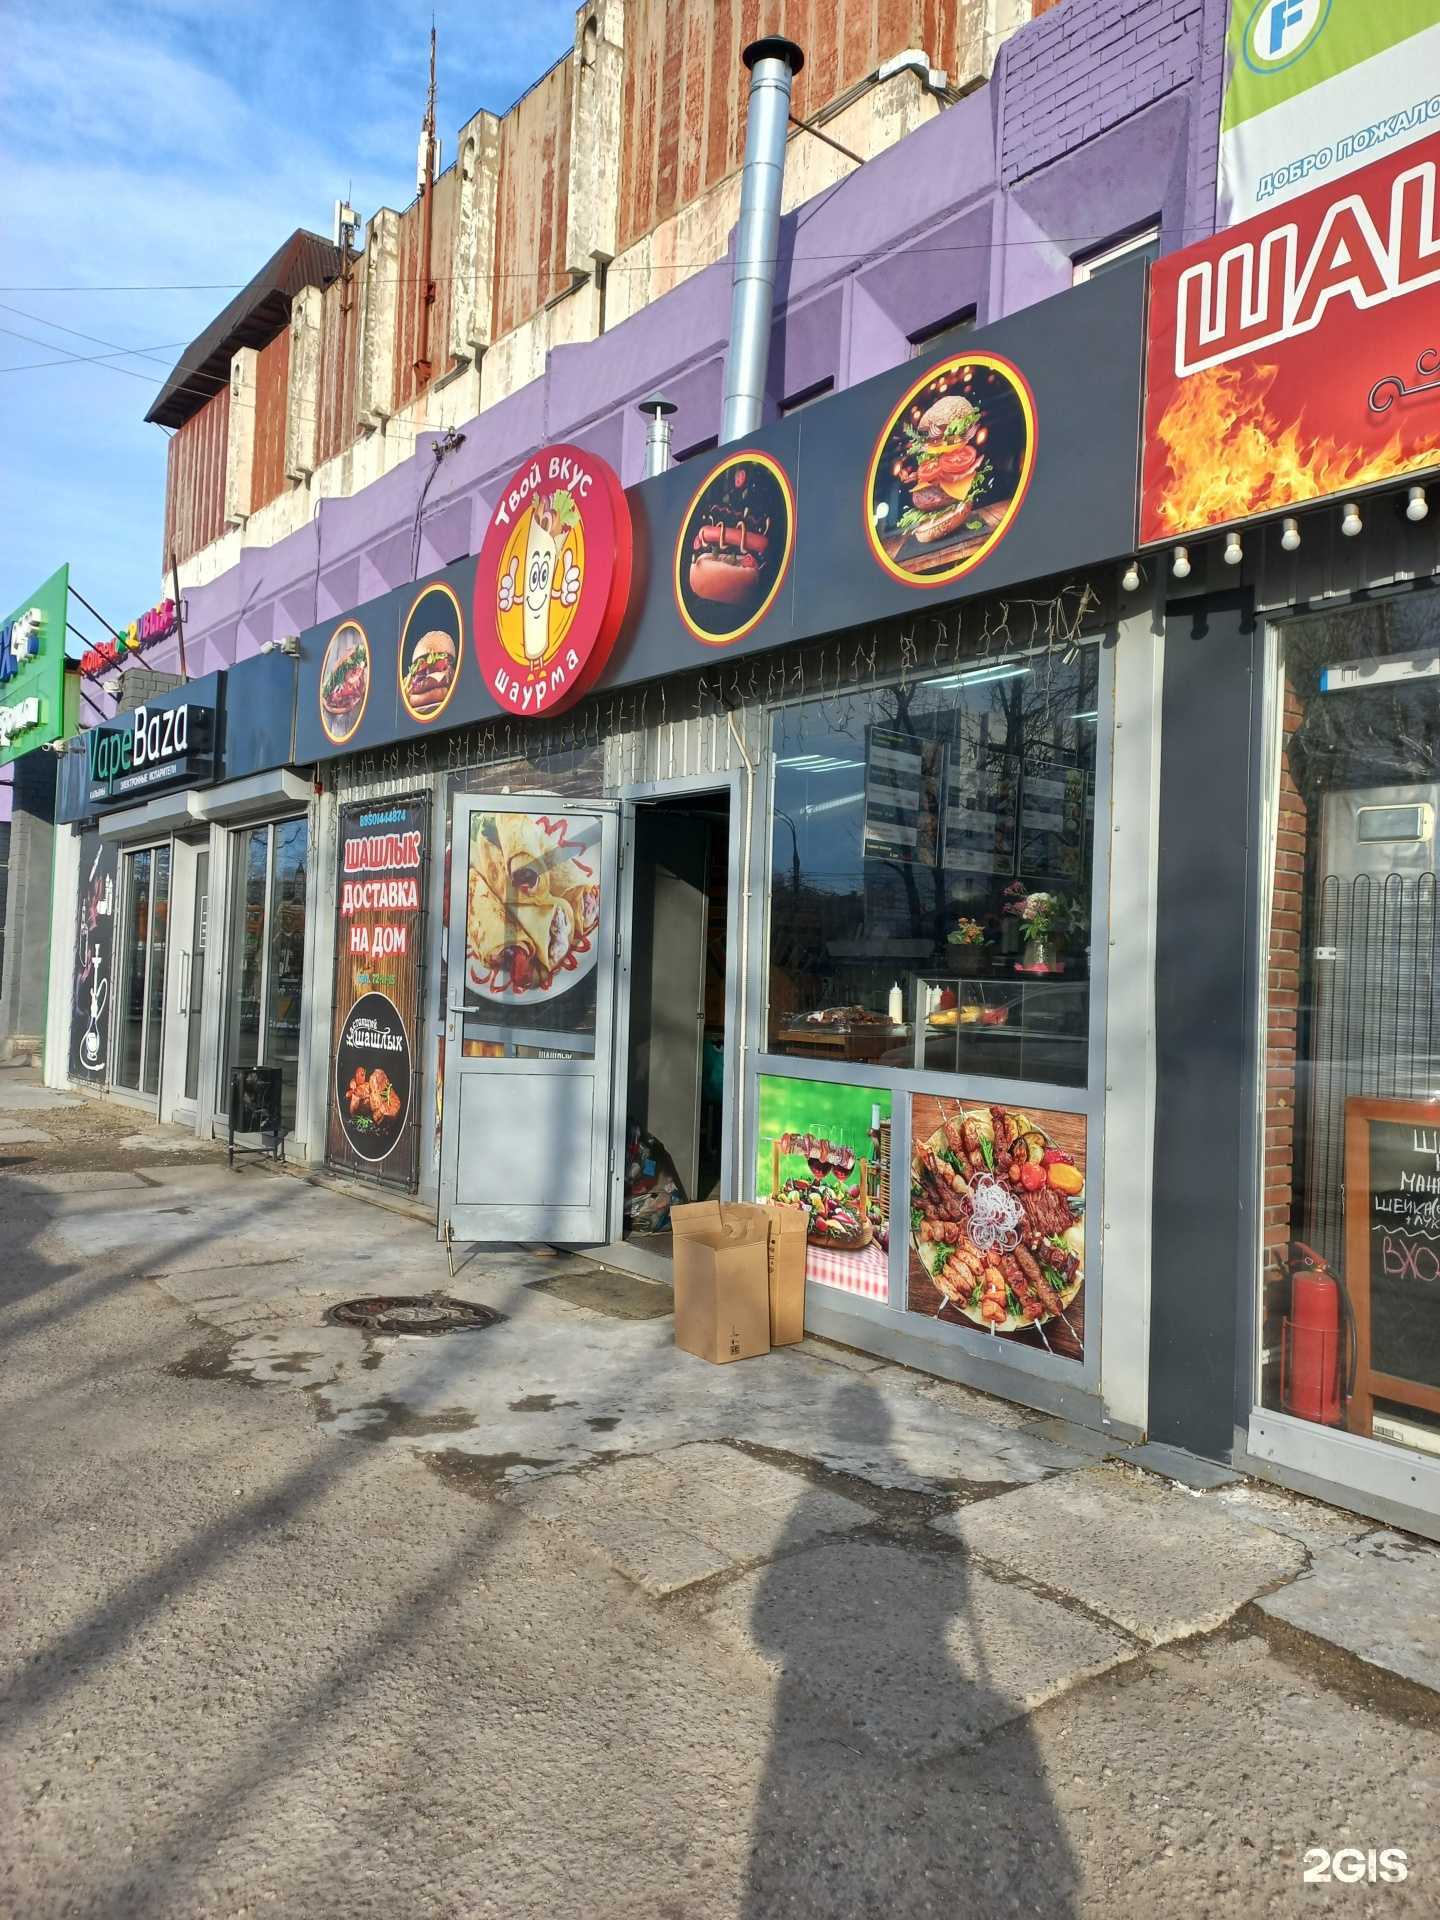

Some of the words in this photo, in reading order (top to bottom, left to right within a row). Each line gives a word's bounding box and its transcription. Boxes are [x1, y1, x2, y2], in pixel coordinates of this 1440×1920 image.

[1256, 147, 1332, 201] ДОБРО
[494, 648, 579, 710] шаурма
[344, 831, 421, 872] ШАШЛЫК
[342, 880, 418, 914] ДОСТАВКА
[351, 927, 369, 953] НА
[372, 925, 406, 958] ДОМ
[1383, 1236, 1440, 1282] ВХО
